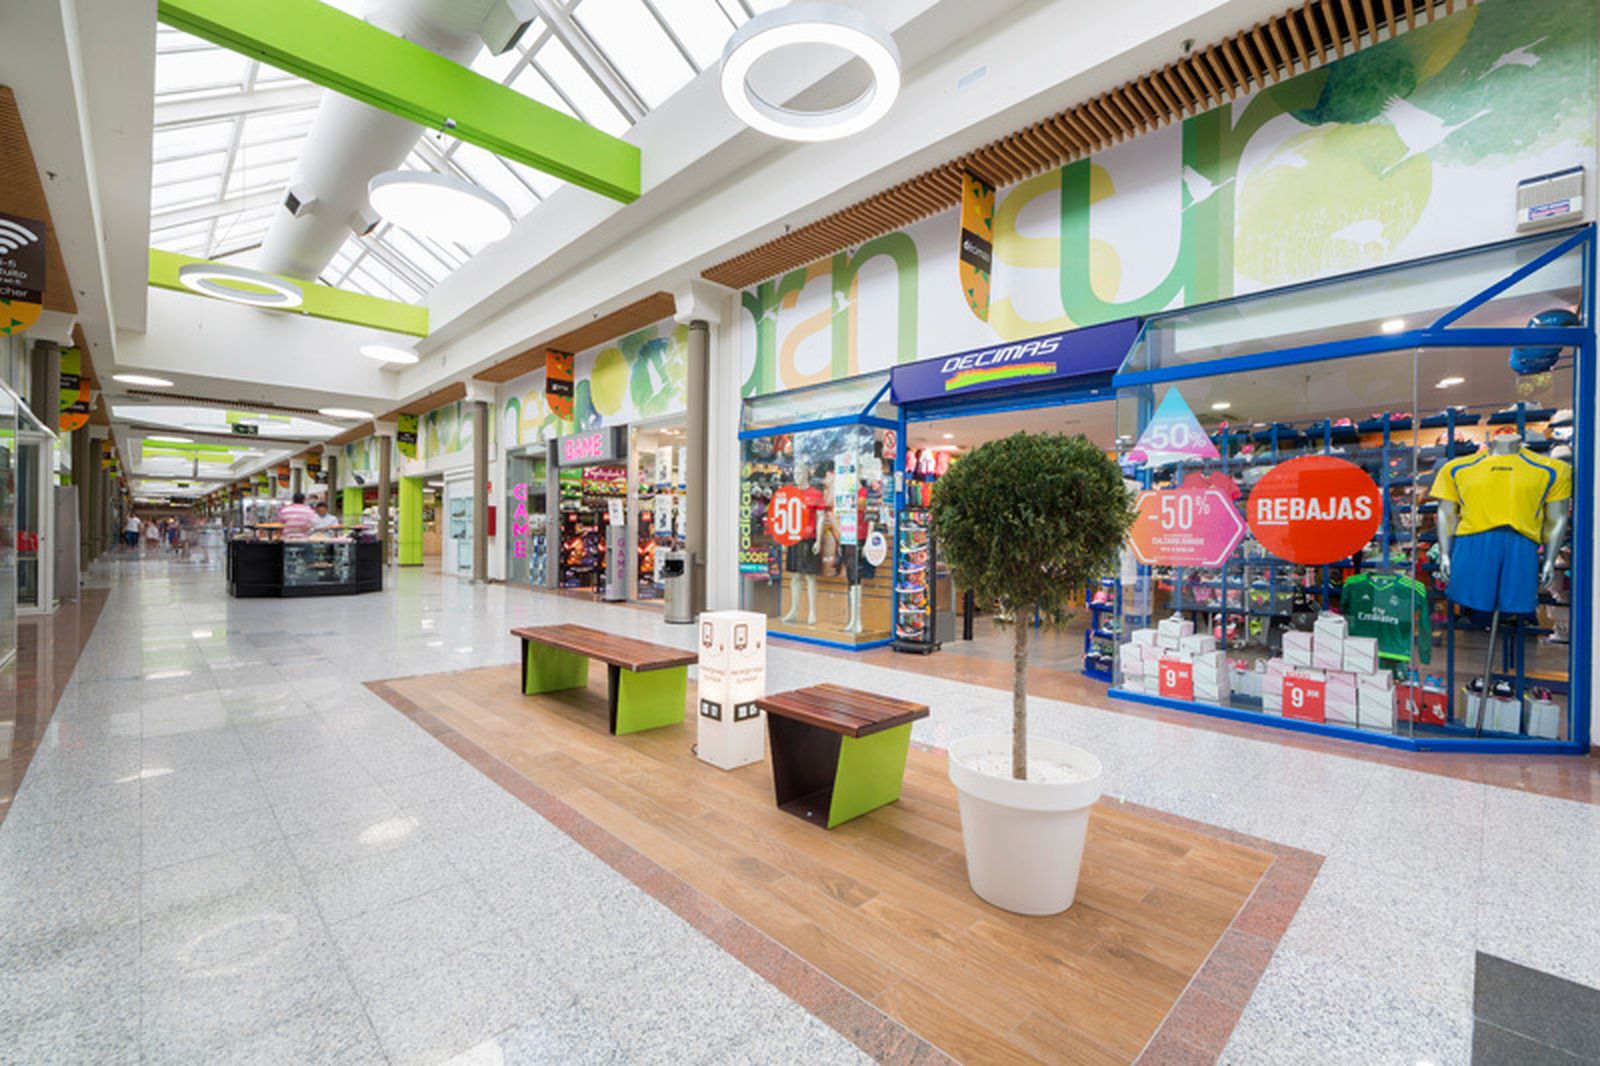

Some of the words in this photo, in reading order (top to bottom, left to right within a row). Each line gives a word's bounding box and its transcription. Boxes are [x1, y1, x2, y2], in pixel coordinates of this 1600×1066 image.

[941, 336, 1063, 374] DECIMAS
[564, 434, 602, 460] GAME
[512, 483, 529, 558] GAME
[740, 482, 752, 549] adidas
[1148, 495, 1210, 530] -50%
[1257, 496, 1372, 521] REBAJAS
[1357, 611, 1399, 625] Emirates
[1165, 669, 1177, 688] 9
[1290, 687, 1304, 708] 9
